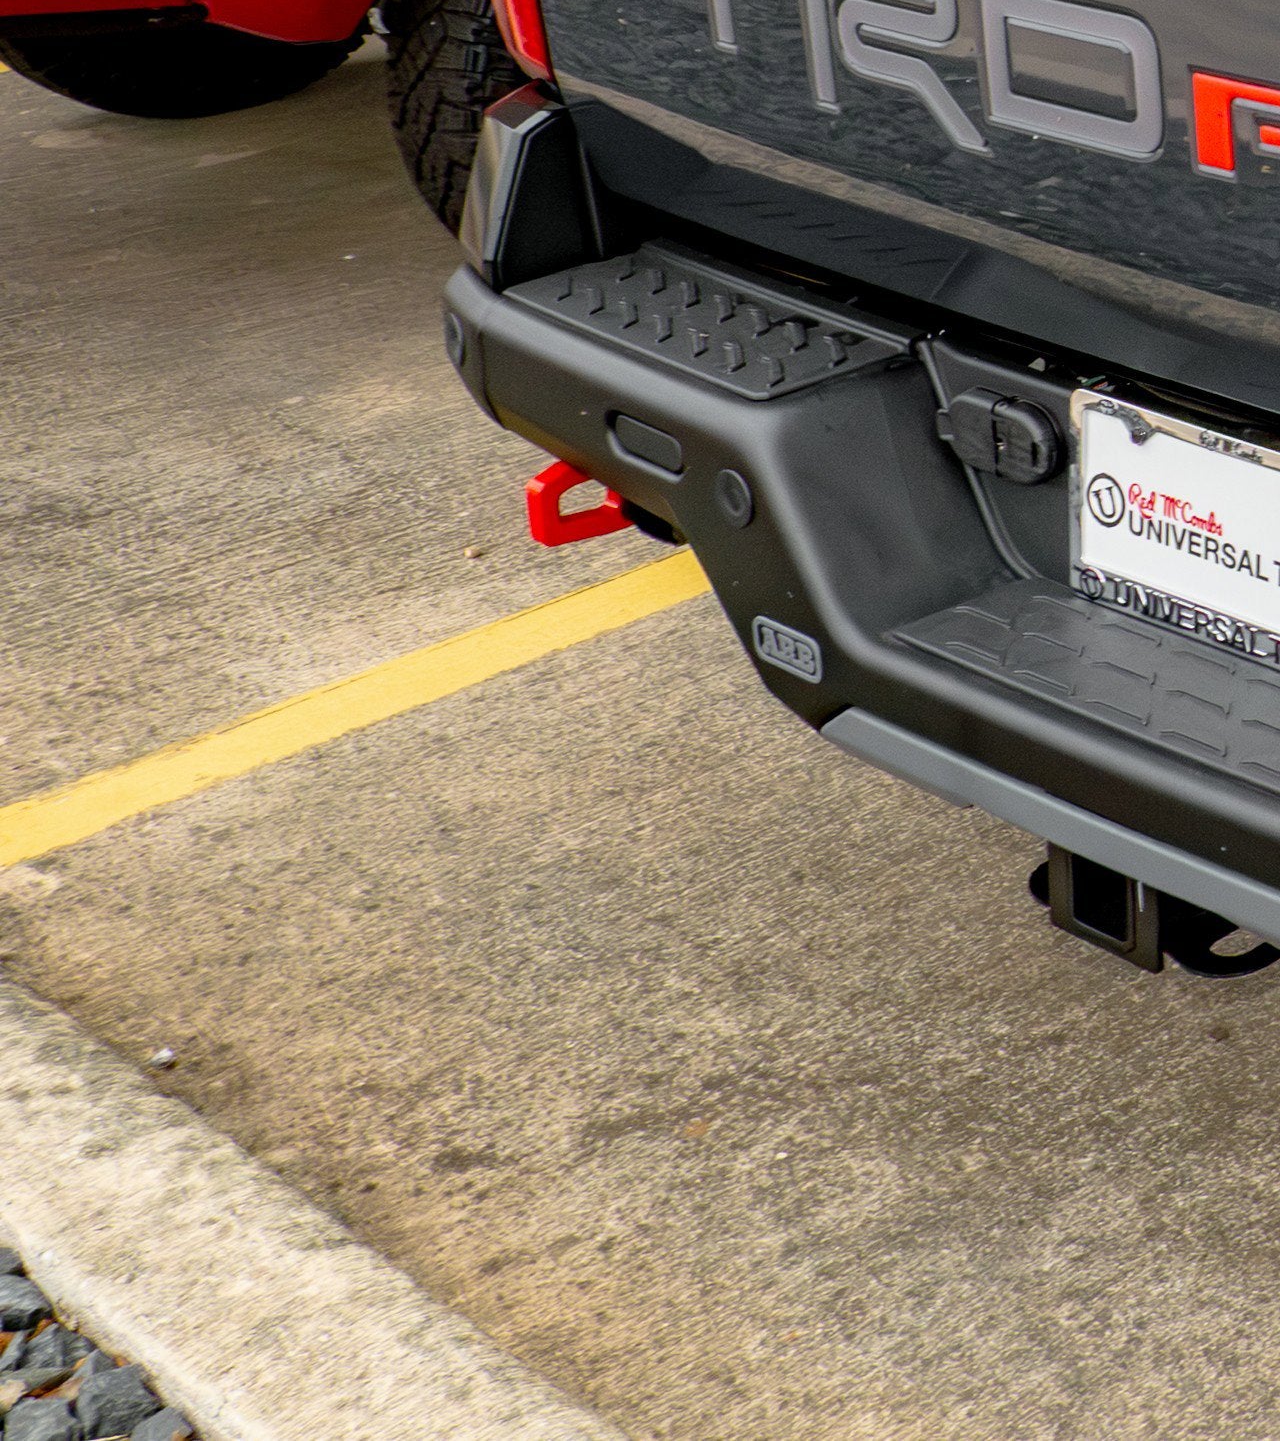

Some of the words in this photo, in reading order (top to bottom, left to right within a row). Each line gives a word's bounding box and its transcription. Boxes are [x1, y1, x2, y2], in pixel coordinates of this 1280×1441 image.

[1128, 483, 1156, 519] Red
[1128, 510, 1269, 582] UNIVERSAL
[1114, 577, 1268, 658] UNIVERSAL
